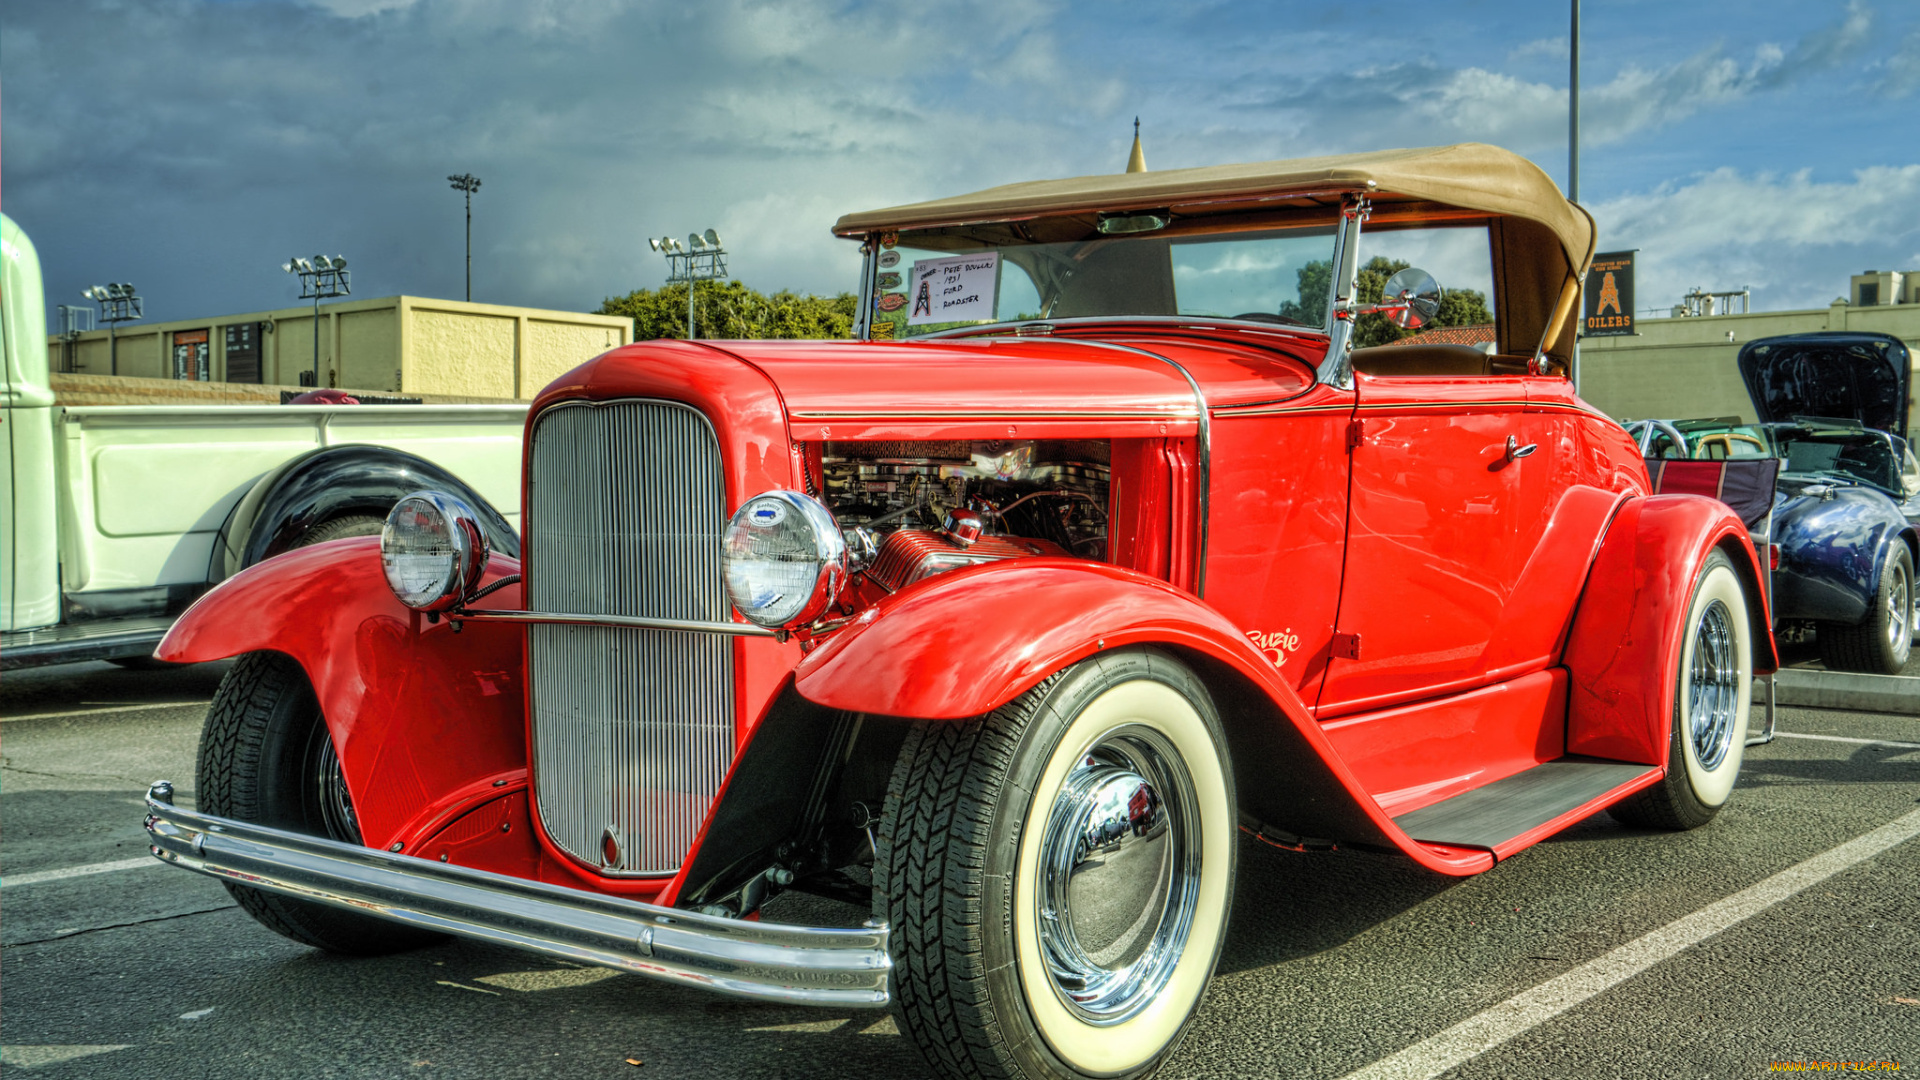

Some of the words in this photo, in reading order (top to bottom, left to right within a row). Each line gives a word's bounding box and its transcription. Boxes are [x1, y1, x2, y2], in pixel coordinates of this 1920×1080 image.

[944, 265, 963, 275] PETE
[944, 273, 960, 284] 1931
[944, 285, 963, 296] FORD
[943, 295, 979, 309] ROADSTER
[1588, 315, 1630, 328] OILERS
